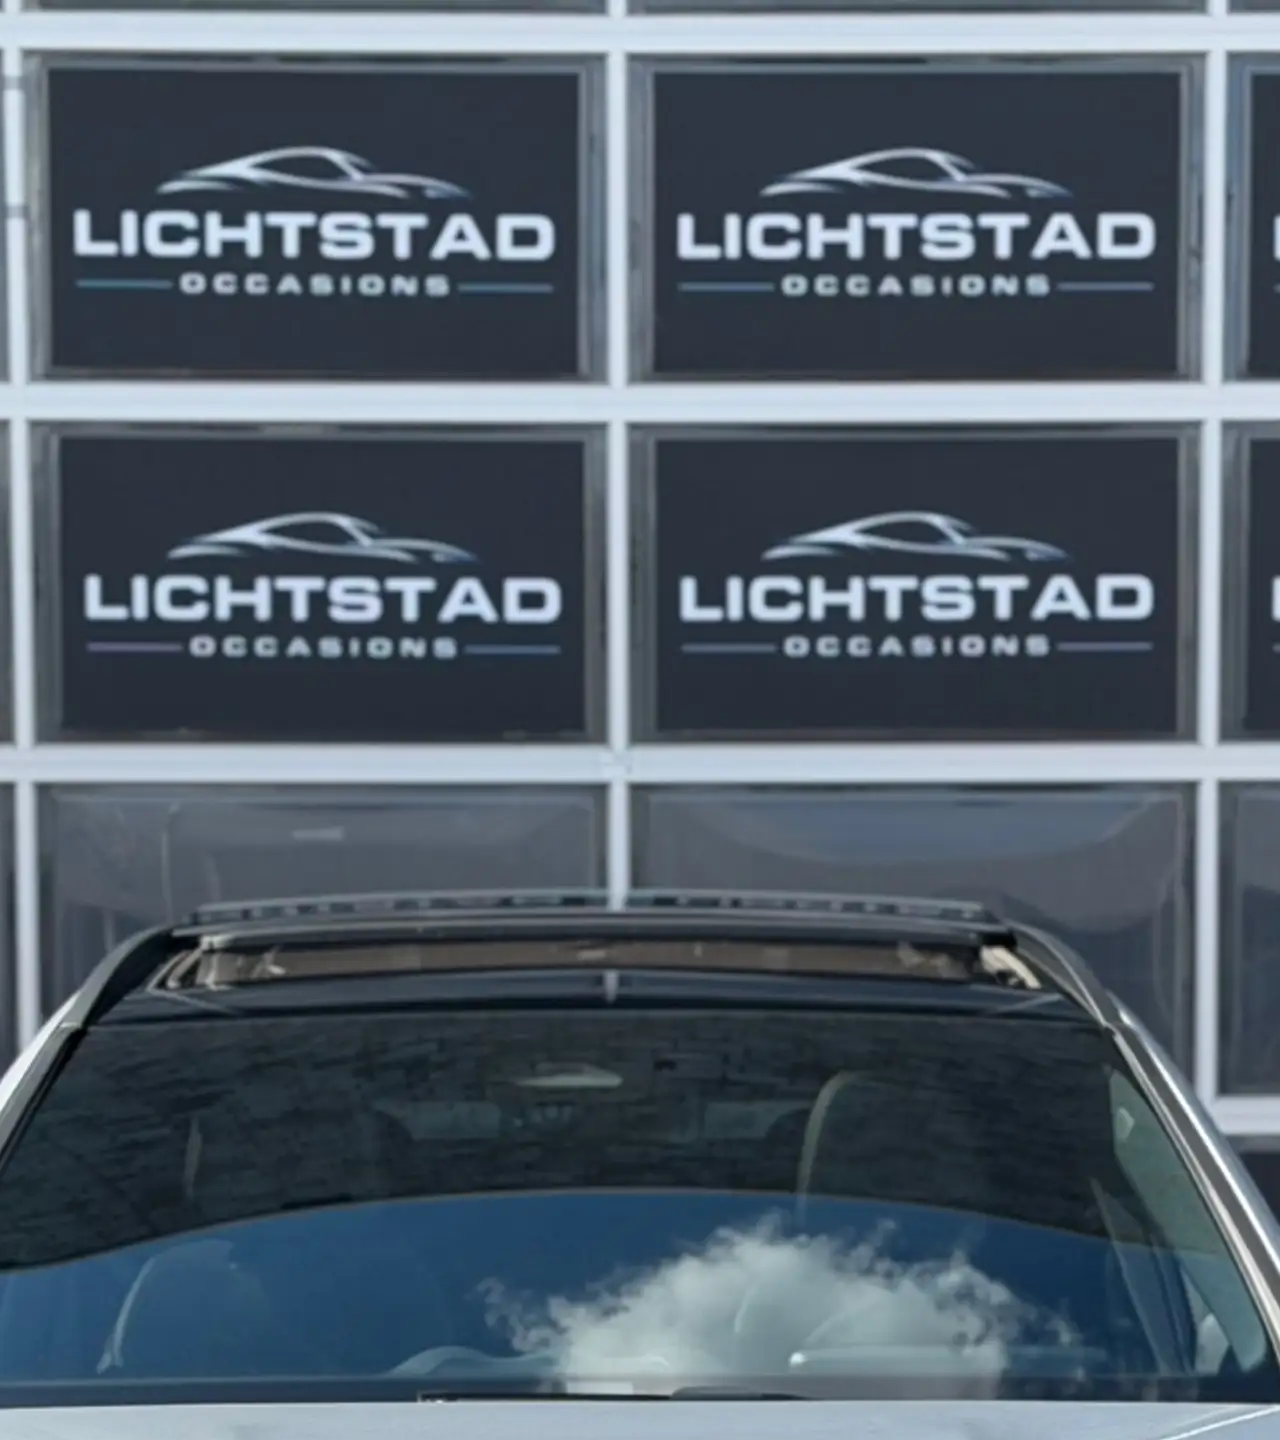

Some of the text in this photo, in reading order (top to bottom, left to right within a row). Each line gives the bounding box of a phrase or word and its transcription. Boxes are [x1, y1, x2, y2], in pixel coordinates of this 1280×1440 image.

[73, 209, 555, 262] LICHTSTAD
[677, 212, 1156, 261] LICHTSTAD
[179, 272, 450, 298] OCCASIONS
[781, 274, 1050, 298] OCCASIONS
[84, 574, 562, 624] LICHTSTAD
[679, 574, 1154, 623] LICHTSTAD
[189, 635, 457, 660] OCCASIONS
[783, 634, 1050, 658] OCCASIONS
